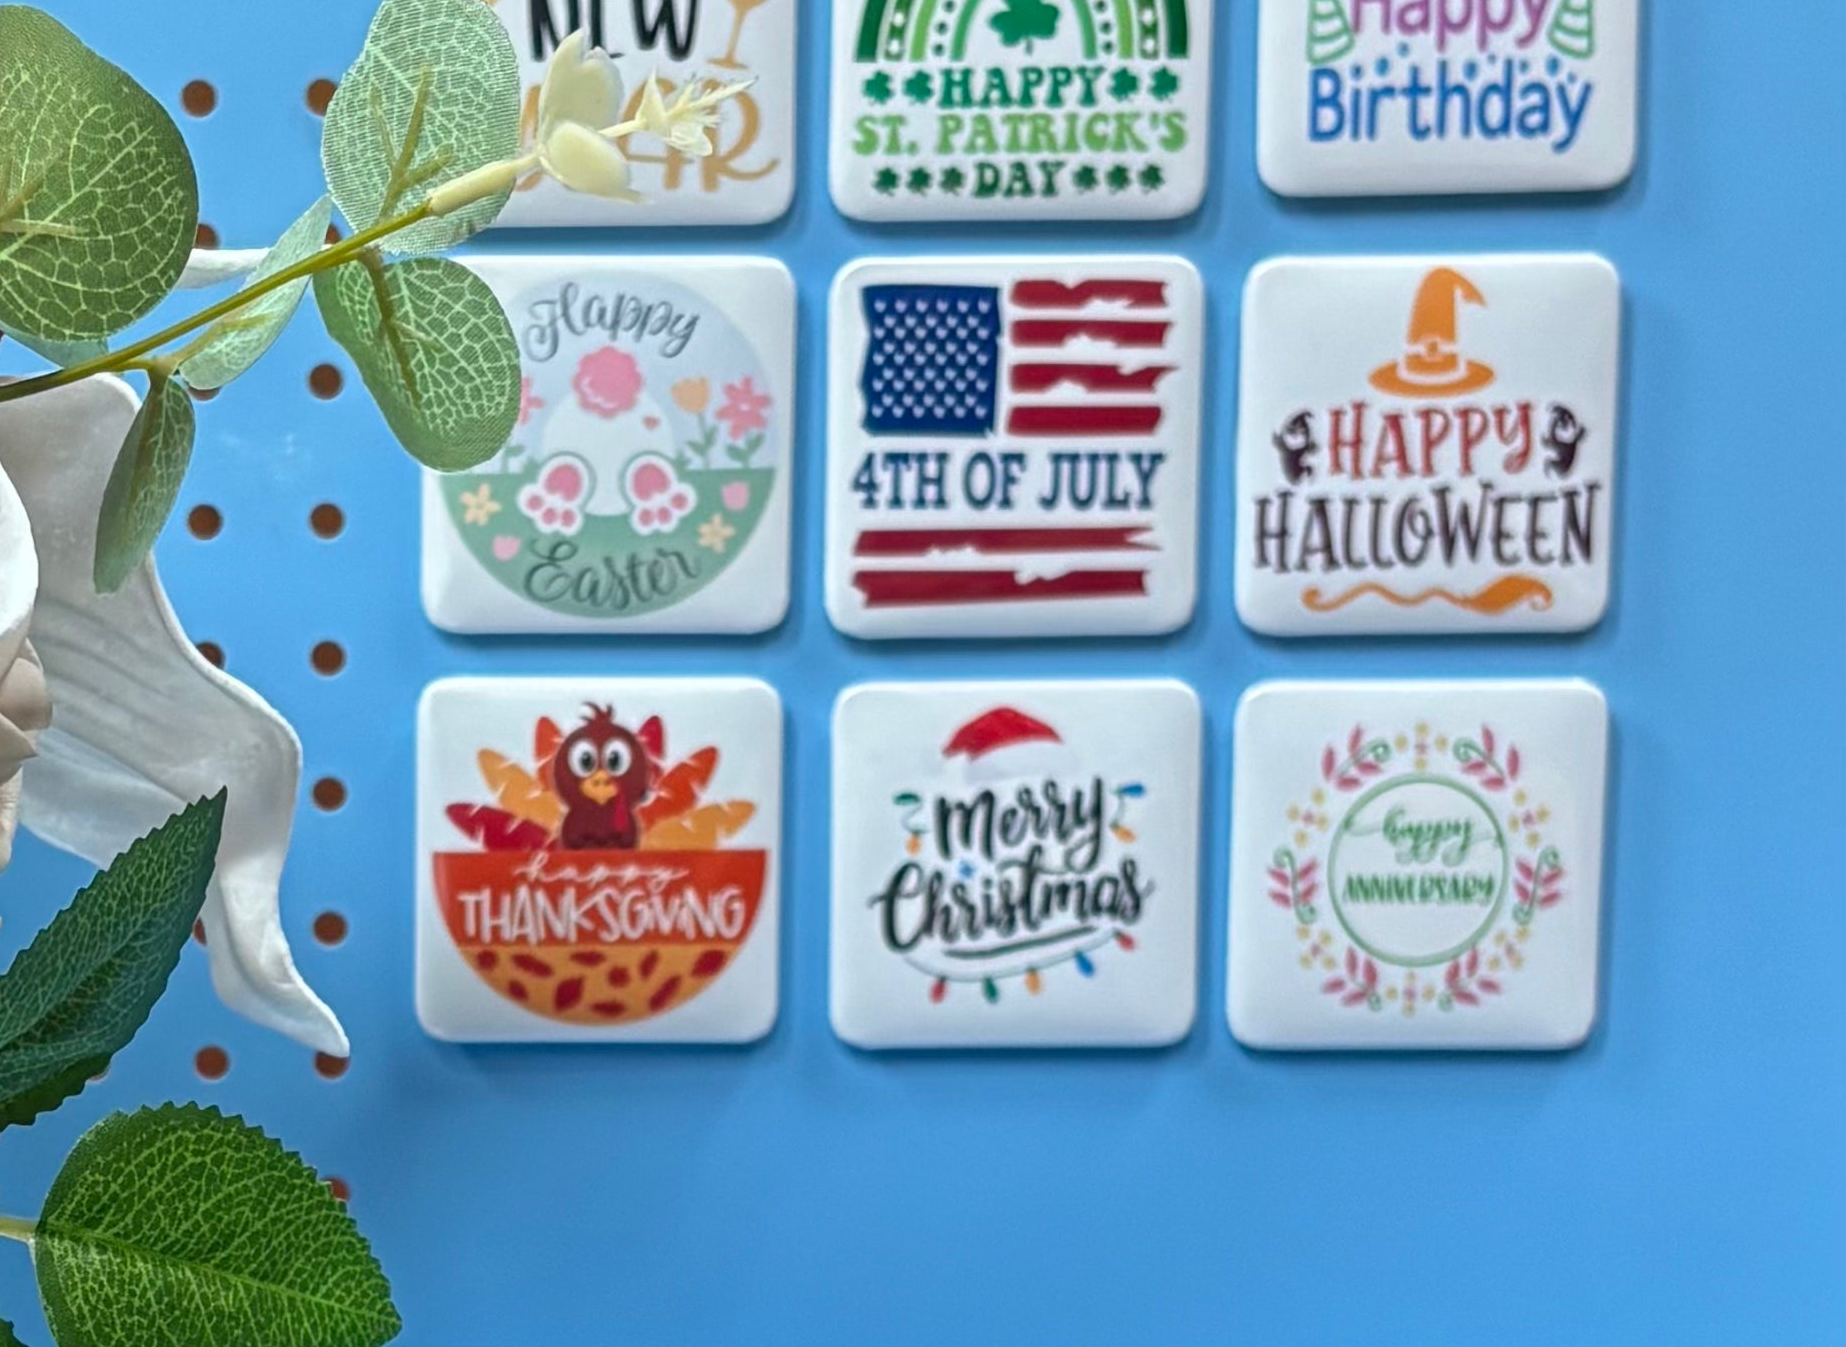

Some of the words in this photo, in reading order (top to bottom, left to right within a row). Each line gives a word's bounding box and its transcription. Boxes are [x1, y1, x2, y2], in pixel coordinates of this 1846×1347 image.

[937, 66, 1106, 108] HAPPY
[1307, 58, 1593, 154] Birthday
[853, 114, 919, 156] ST.
[937, 111, 1188, 154] PATRICK'S
[971, 161, 1066, 198] DAY
[523, 281, 701, 363] Happy
[1327, 398, 1535, 481] HAPPY
[852, 453, 949, 511] 4TH
[962, 452, 1026, 511] OF
[1037, 452, 1166, 512] JULY
[1253, 479, 1601, 573] HALLOWEEN
[523, 537, 702, 611] Easter
[514, 850, 689, 894] happy
[867, 844, 1156, 954] Christmas
[1342, 873, 1495, 906] ANNIVERSARY
